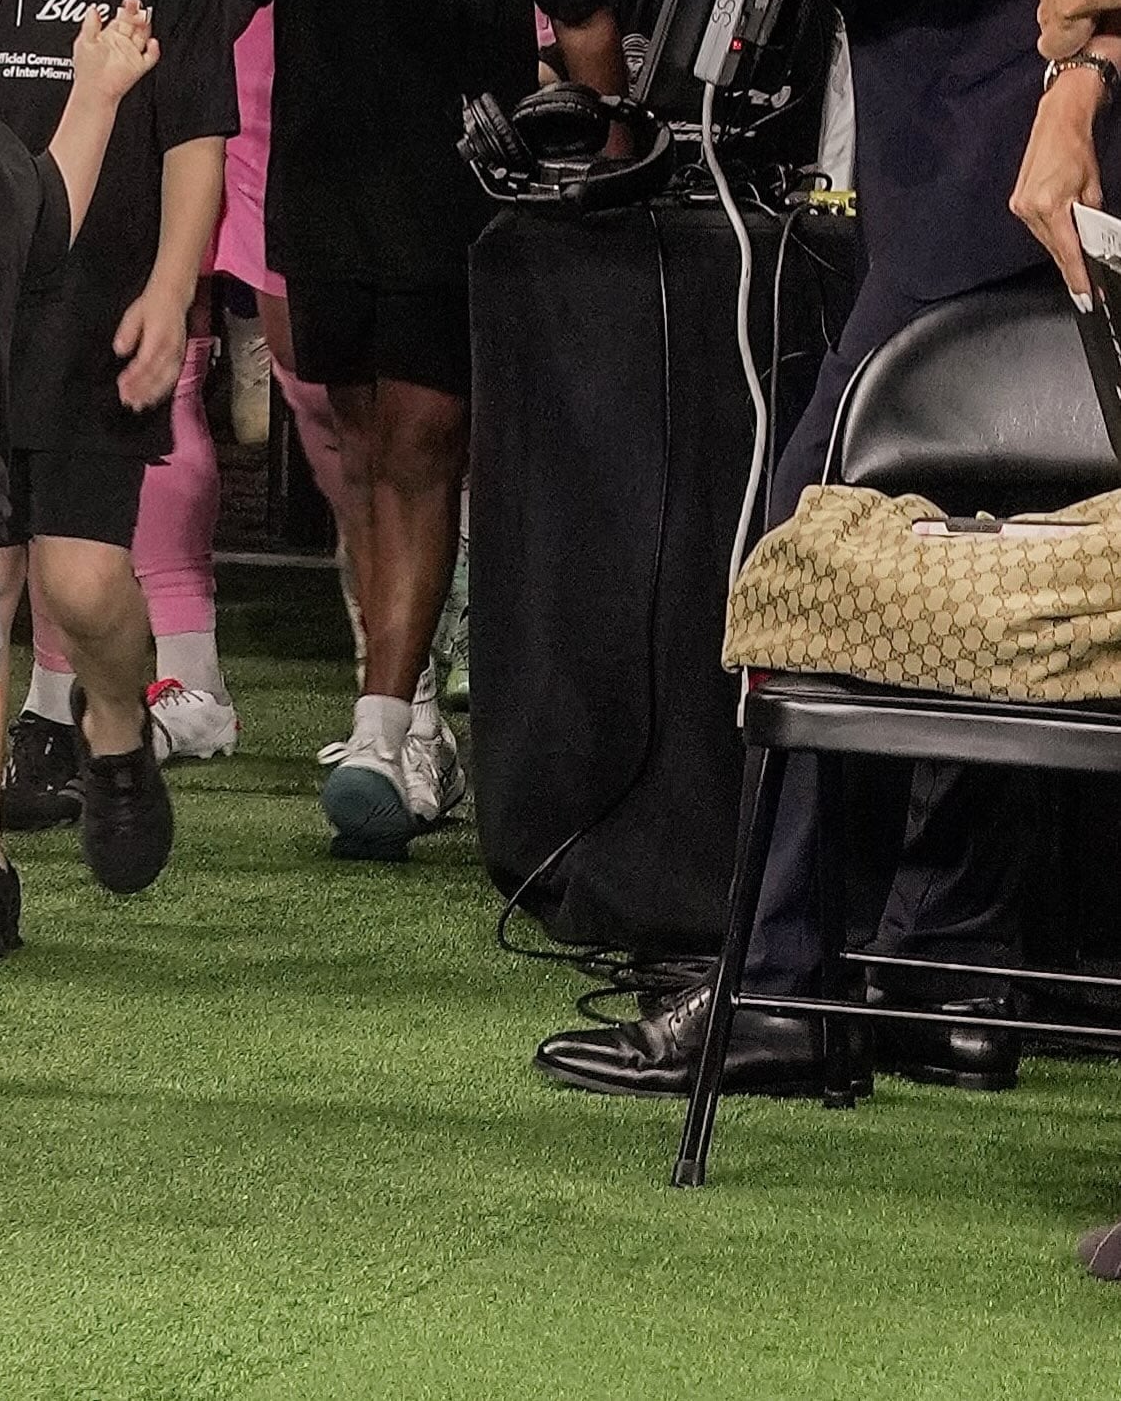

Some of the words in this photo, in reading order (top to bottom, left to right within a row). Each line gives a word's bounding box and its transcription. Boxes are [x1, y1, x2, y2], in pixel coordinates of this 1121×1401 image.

[27, 53, 74, 67] Commun
[2, 65, 15, 78] of
[15, 65, 39, 78] Inter
[39, 66, 73, 81] Miami
